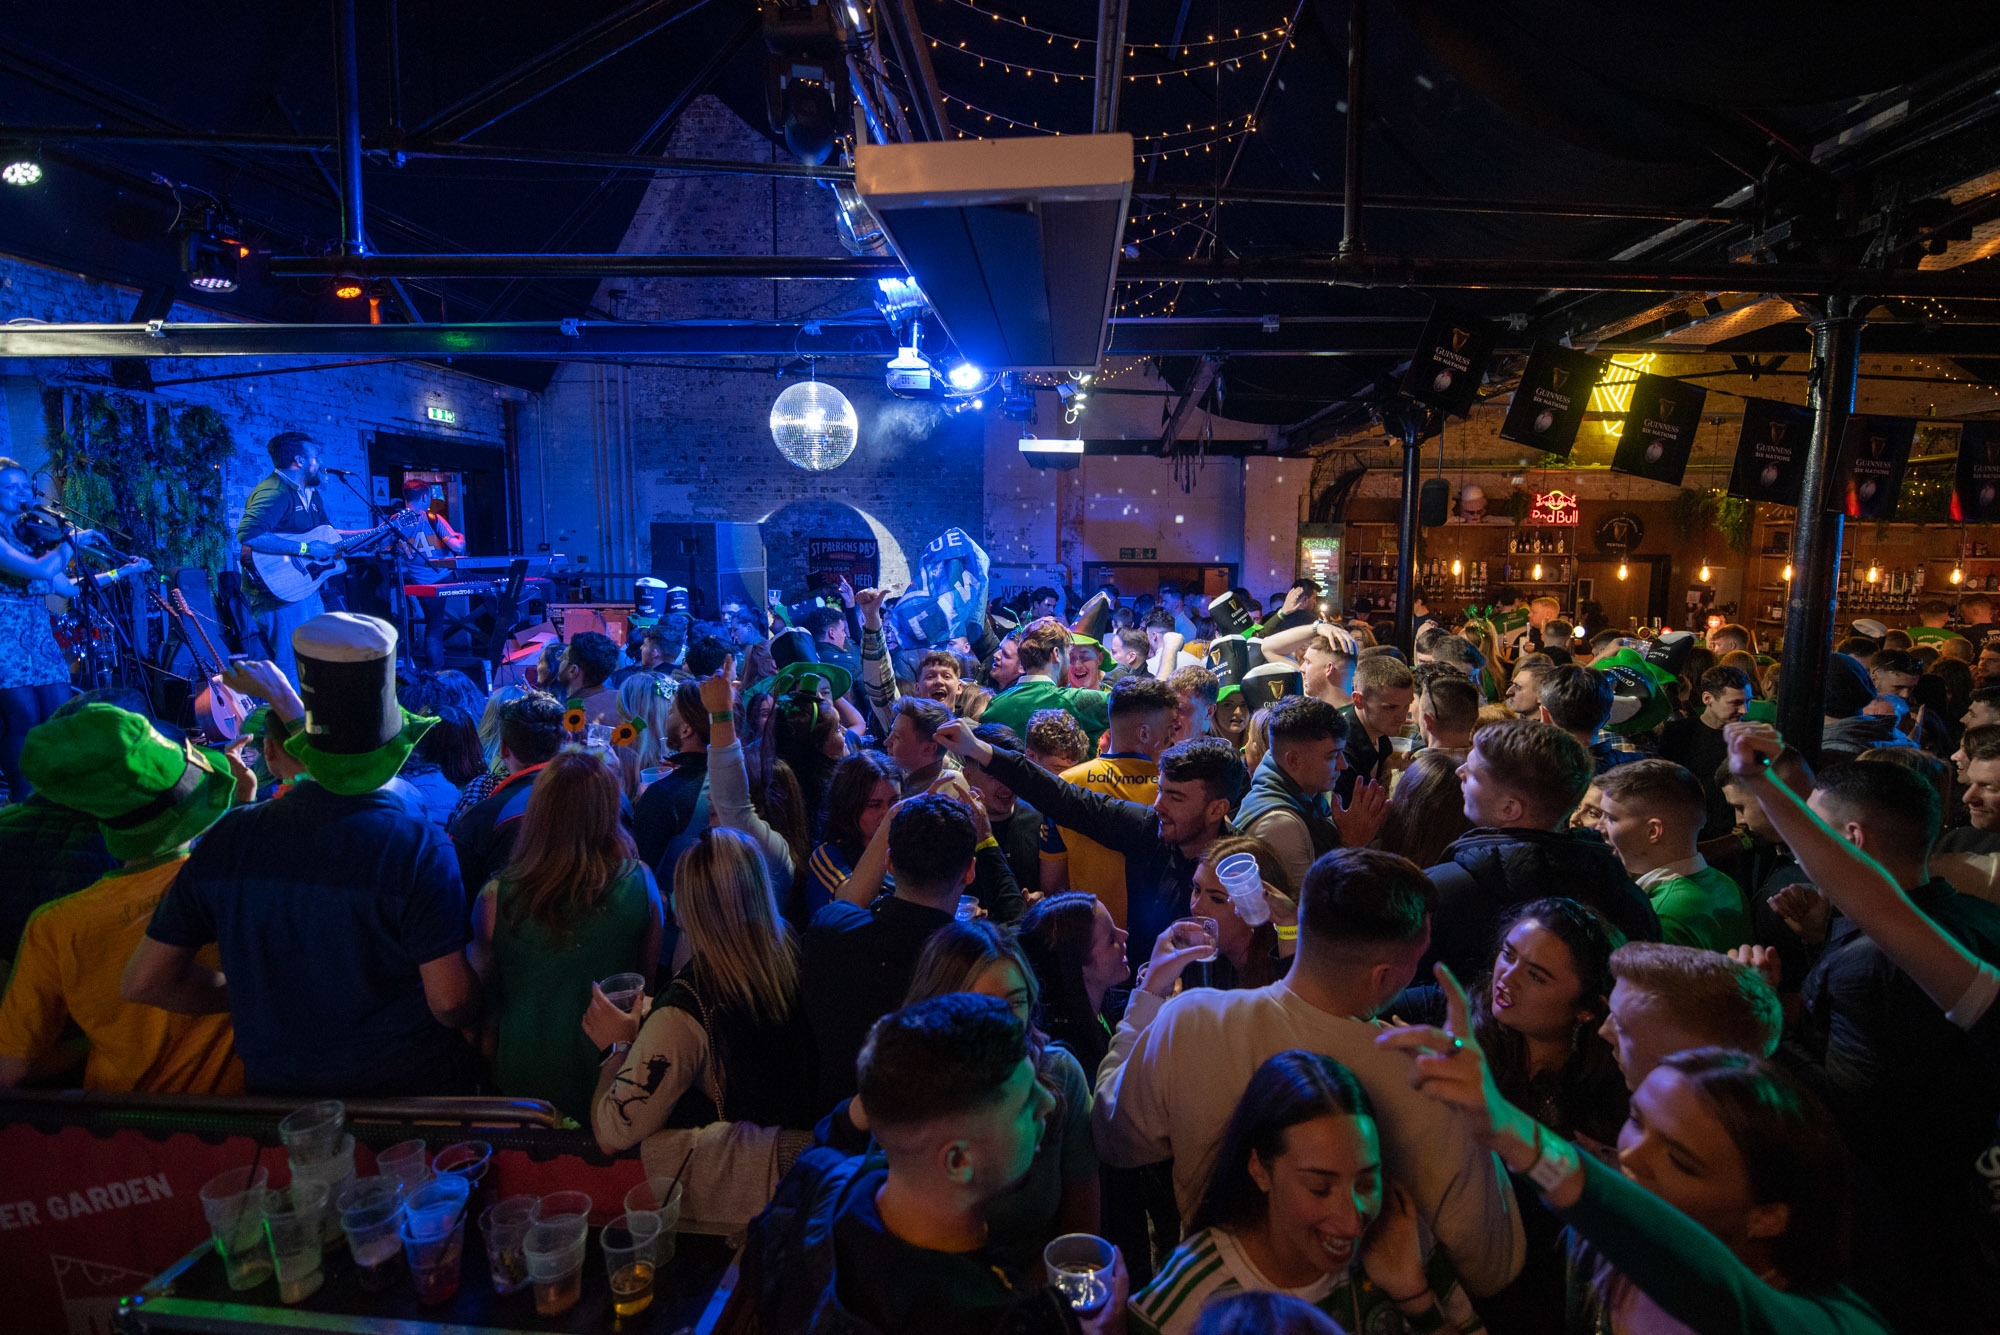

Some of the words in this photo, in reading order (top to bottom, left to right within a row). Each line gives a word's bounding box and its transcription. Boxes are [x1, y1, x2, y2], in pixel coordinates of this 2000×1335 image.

[1435, 346, 1471, 366] GUINNESS
[1442, 359, 1468, 373] NATIONS
[1535, 386, 1571, 404] GUINNESS
[1543, 399, 1568, 411] NATIONS
[1643, 418, 1680, 433] GUINNESS
[1652, 430, 1677, 440] NATIONS
[1756, 442, 1792, 455] GUINNESS
[1765, 454, 1791, 462] NATIONS
[1855, 458, 1891, 468] GUINNESS
[1556, 510, 1578, 523] Bull
[859, 541, 876, 558] DAY
[926, 532, 962, 553] UE
[854, 574, 873, 587] HEED
[1087, 767, 1159, 789] ballymore
[0, 1201, 41, 1231] ER
[46, 1173, 174, 1220] GARDEN
